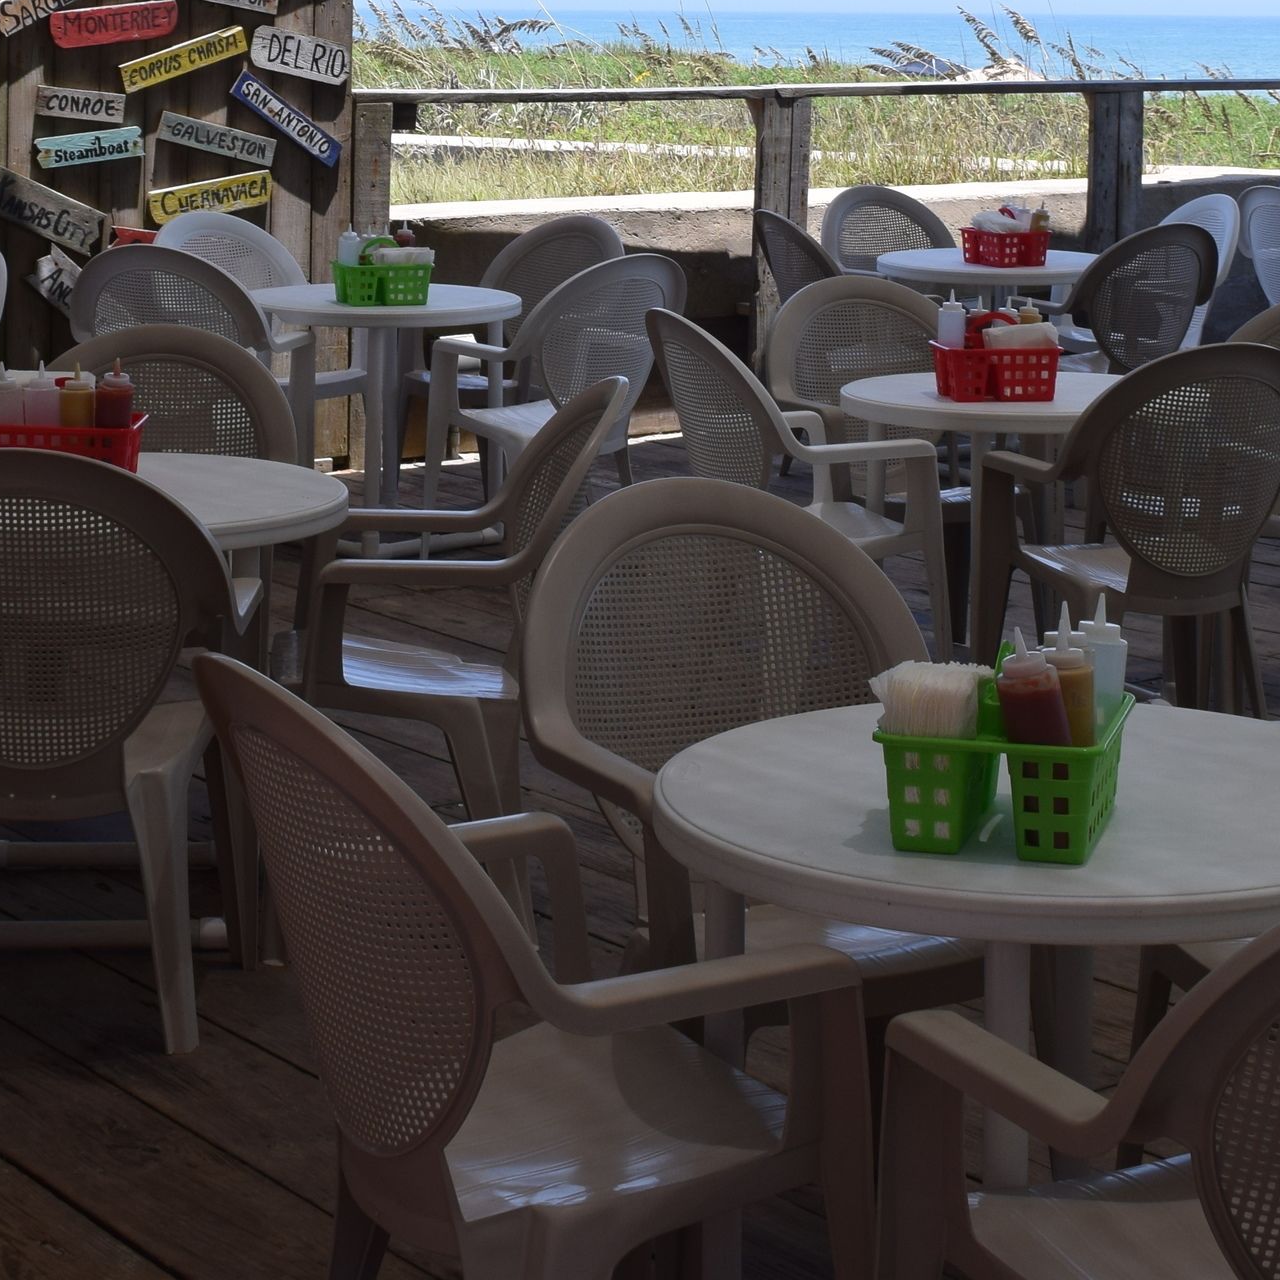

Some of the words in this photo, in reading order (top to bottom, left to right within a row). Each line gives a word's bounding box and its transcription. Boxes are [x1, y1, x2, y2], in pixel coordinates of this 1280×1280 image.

[63, 7, 175, 35] MONTERREY
[268, 33, 304, 70] DEL
[311, 44, 345, 78] RIO
[46, 95, 115, 116] CONROE
[242, 80, 272, 109] SAN
[273, 106, 330, 154] ANTONIO
[55, 136, 130, 163] Steamboat
[172, 122, 266, 160] GALVESTON
